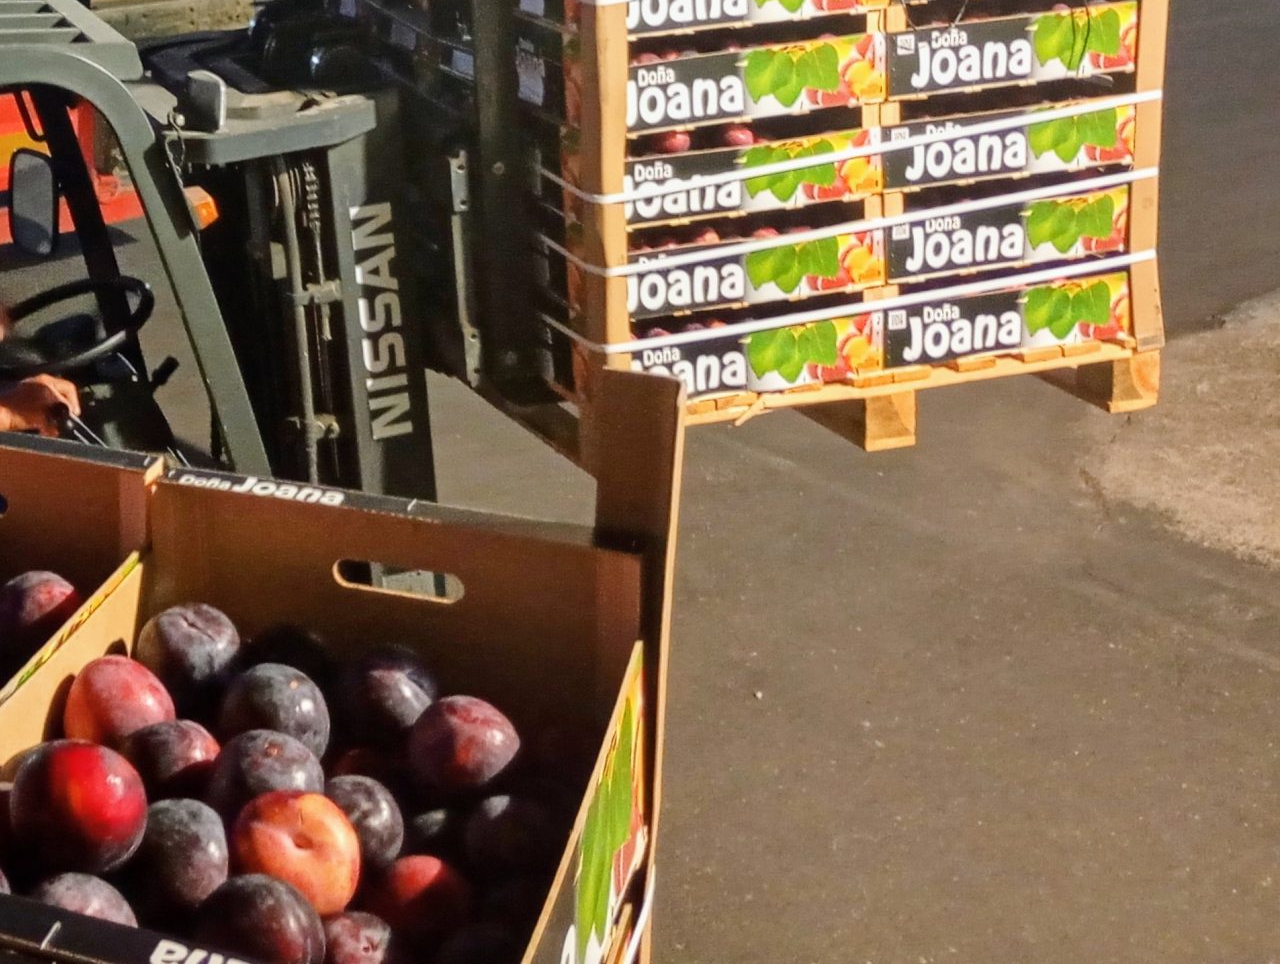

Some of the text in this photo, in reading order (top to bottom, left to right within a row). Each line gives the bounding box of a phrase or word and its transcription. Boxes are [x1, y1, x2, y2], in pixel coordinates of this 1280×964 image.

[931, 28, 968, 49] Doña
[637, 65, 675, 86] Doña
[911, 41, 1032, 88] Joana
[626, 75, 744, 127] Joana
[634, 161, 672, 182] Doña
[905, 132, 1026, 181] Joana
[906, 223, 1024, 272] Joana
[349, 202, 413, 440] NISSAN
[923, 303, 960, 324] Doña
[902, 311, 1021, 361] Joana
[642, 347, 680, 366] Doña
[178, 474, 345, 506] Doña Joana
